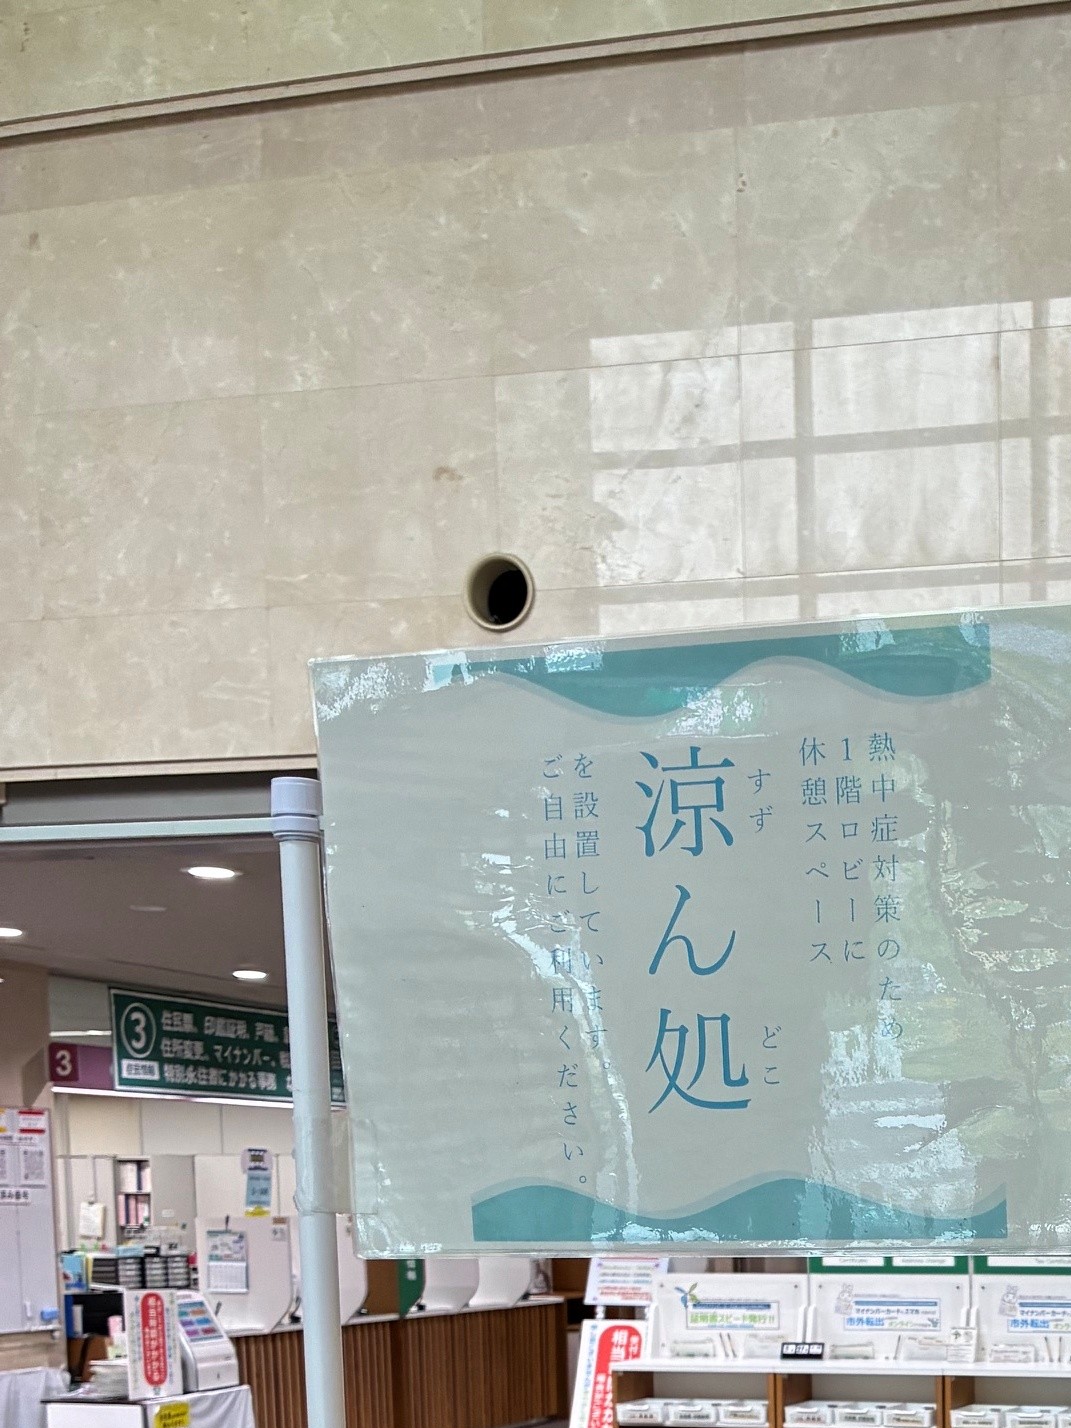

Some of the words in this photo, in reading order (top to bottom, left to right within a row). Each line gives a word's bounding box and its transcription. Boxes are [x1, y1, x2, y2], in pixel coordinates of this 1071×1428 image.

[572, 752, 612, 1071] を設置しています。
[747, 768, 773, 834] すず
[799, 737, 832, 963] 休憩スペース
[835, 737, 866, 963] 1階ロビーに
[869, 732, 903, 1040] 熱中症対策のため
[131, 1011, 146, 1049] 3
[541, 753, 588, 1186] ご自由にご利用ください。
[634, 745, 752, 1114] 涼ん処
[55, 1050, 72, 1077] 3
[761, 1025, 783, 1085] どこ
